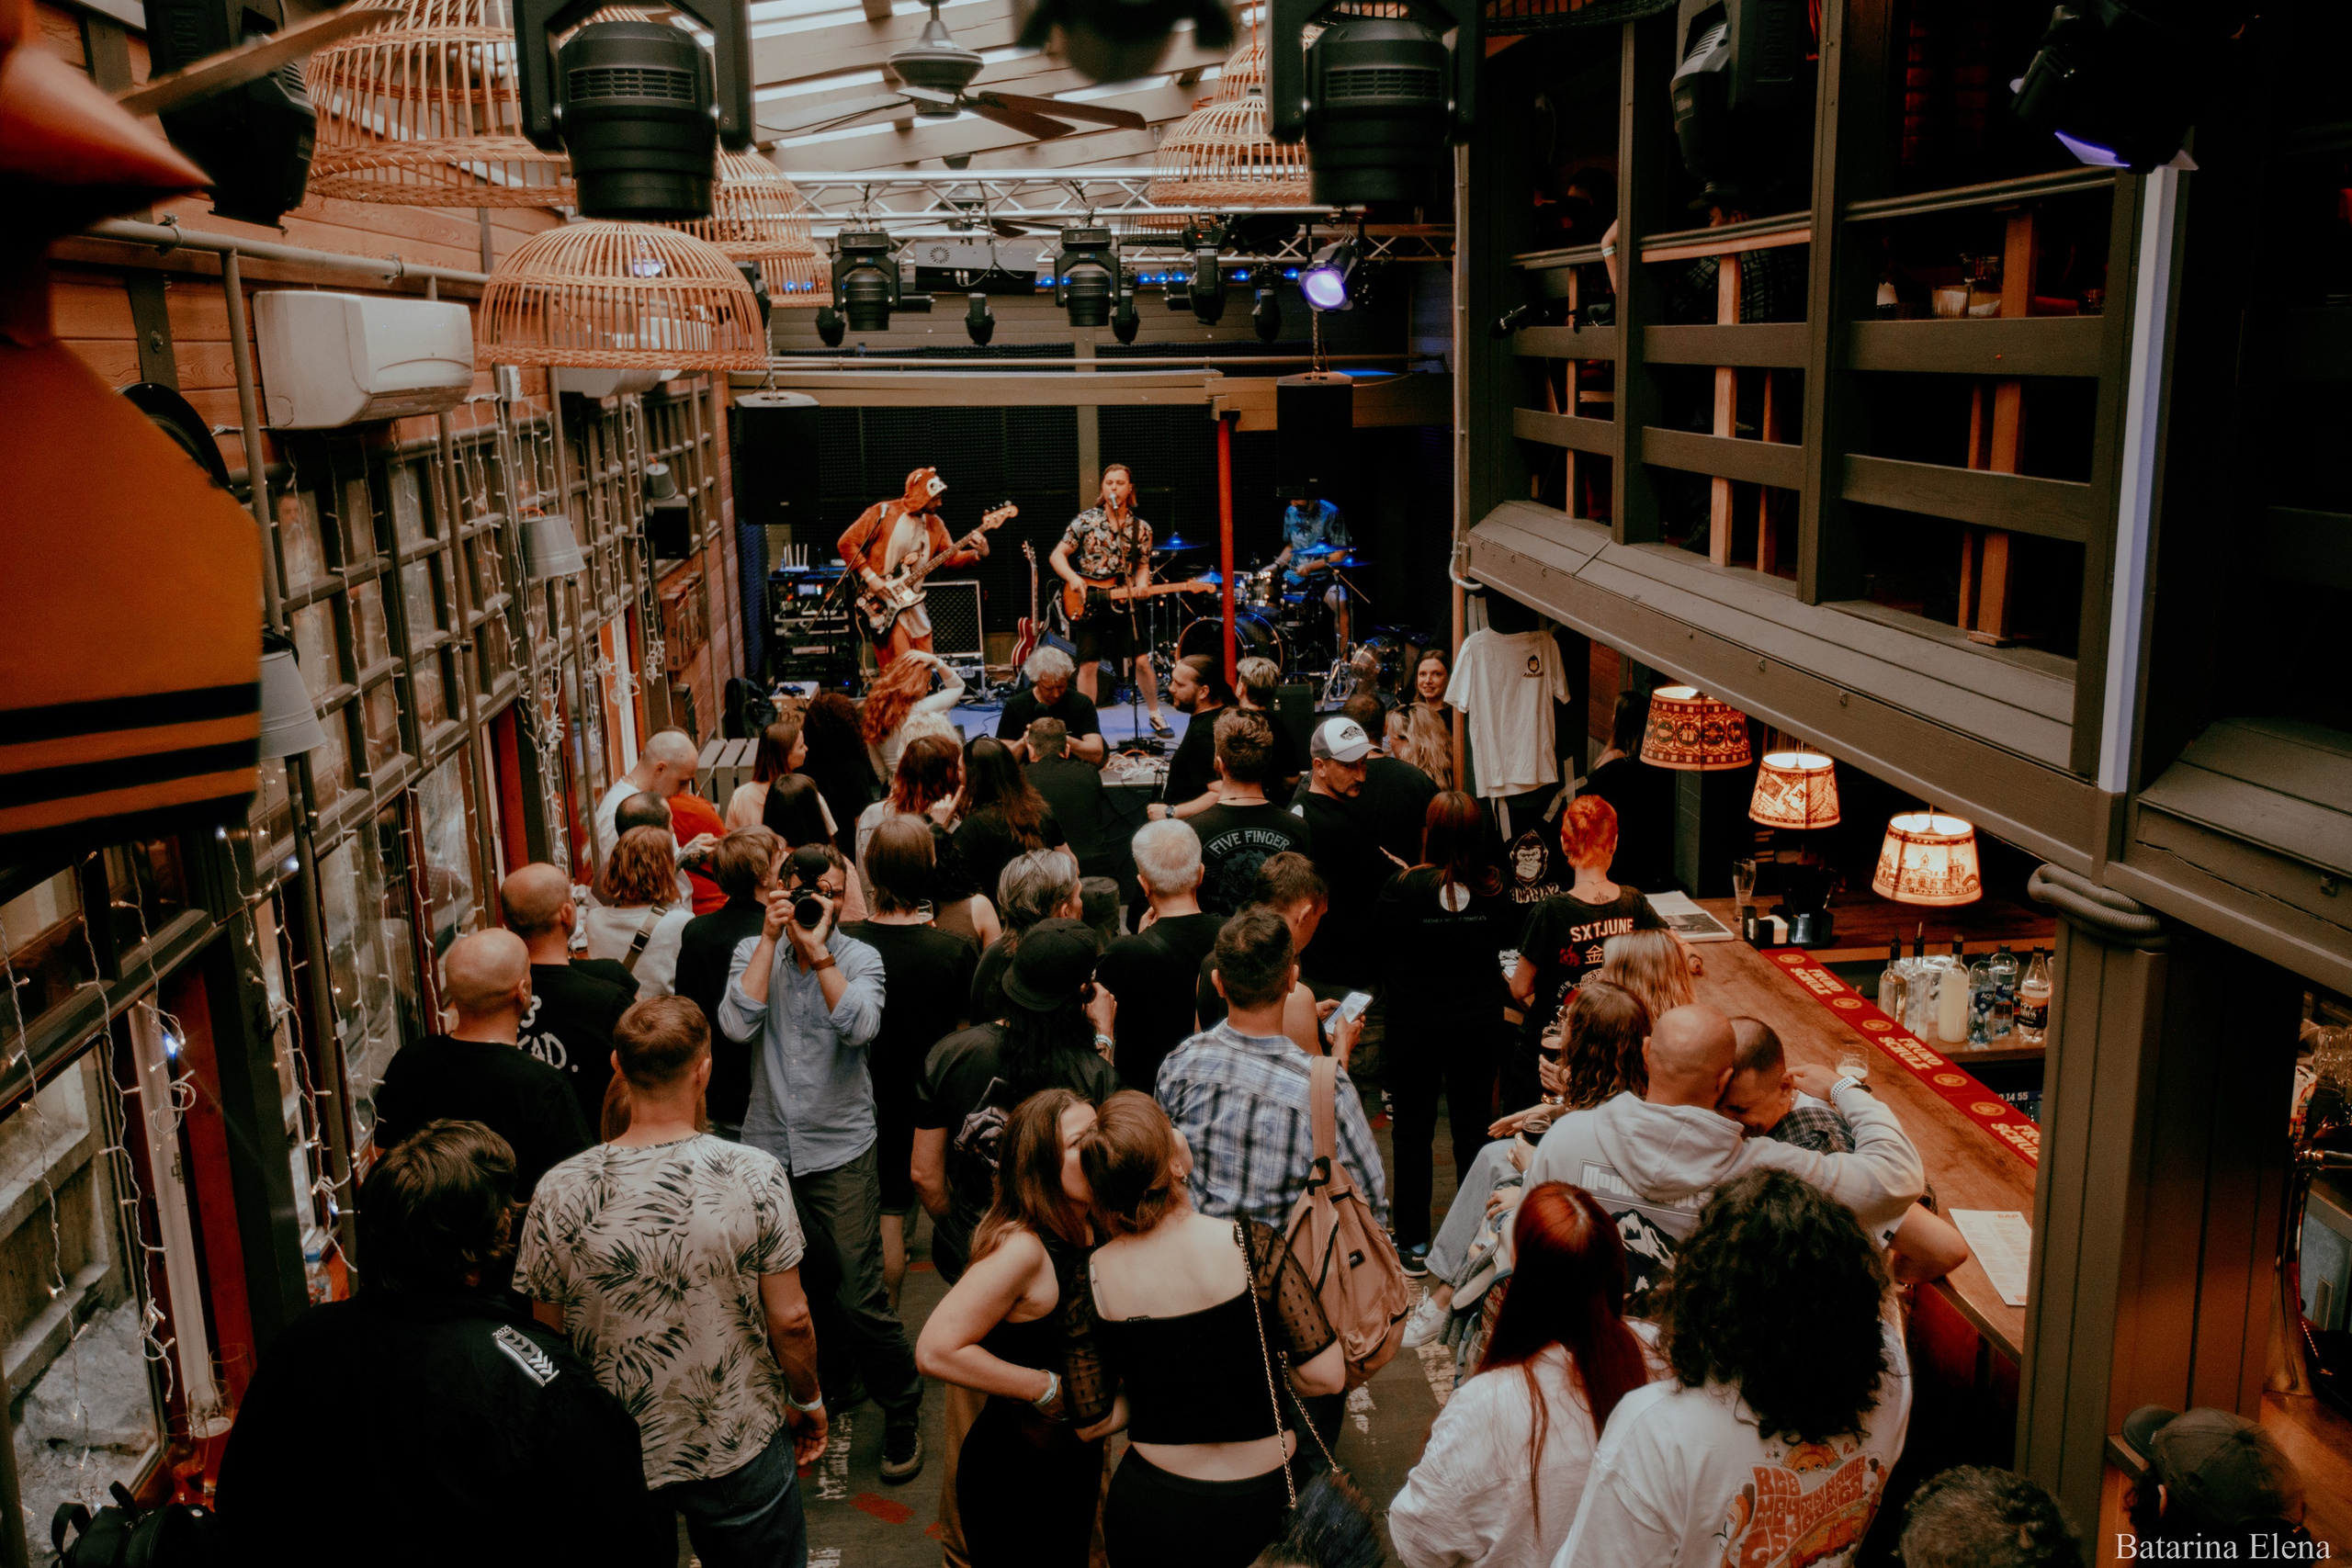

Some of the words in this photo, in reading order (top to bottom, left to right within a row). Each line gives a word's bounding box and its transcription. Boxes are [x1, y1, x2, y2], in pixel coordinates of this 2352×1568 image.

[1209, 832, 1241, 855] FIVE
[1245, 830, 1290, 852] FINGER
[1569, 919, 1634, 942] SXTJUNE
[1790, 967, 1833, 995] SCHULZ
[1807, 968, 1845, 992] FRUKO
[1878, 1036, 1932, 1069] SCHULZ
[1897, 1038, 1944, 1066] FRUKO
[2018, 1091, 2029, 1101] 55
[492, 1325, 512, 1339] 2025
